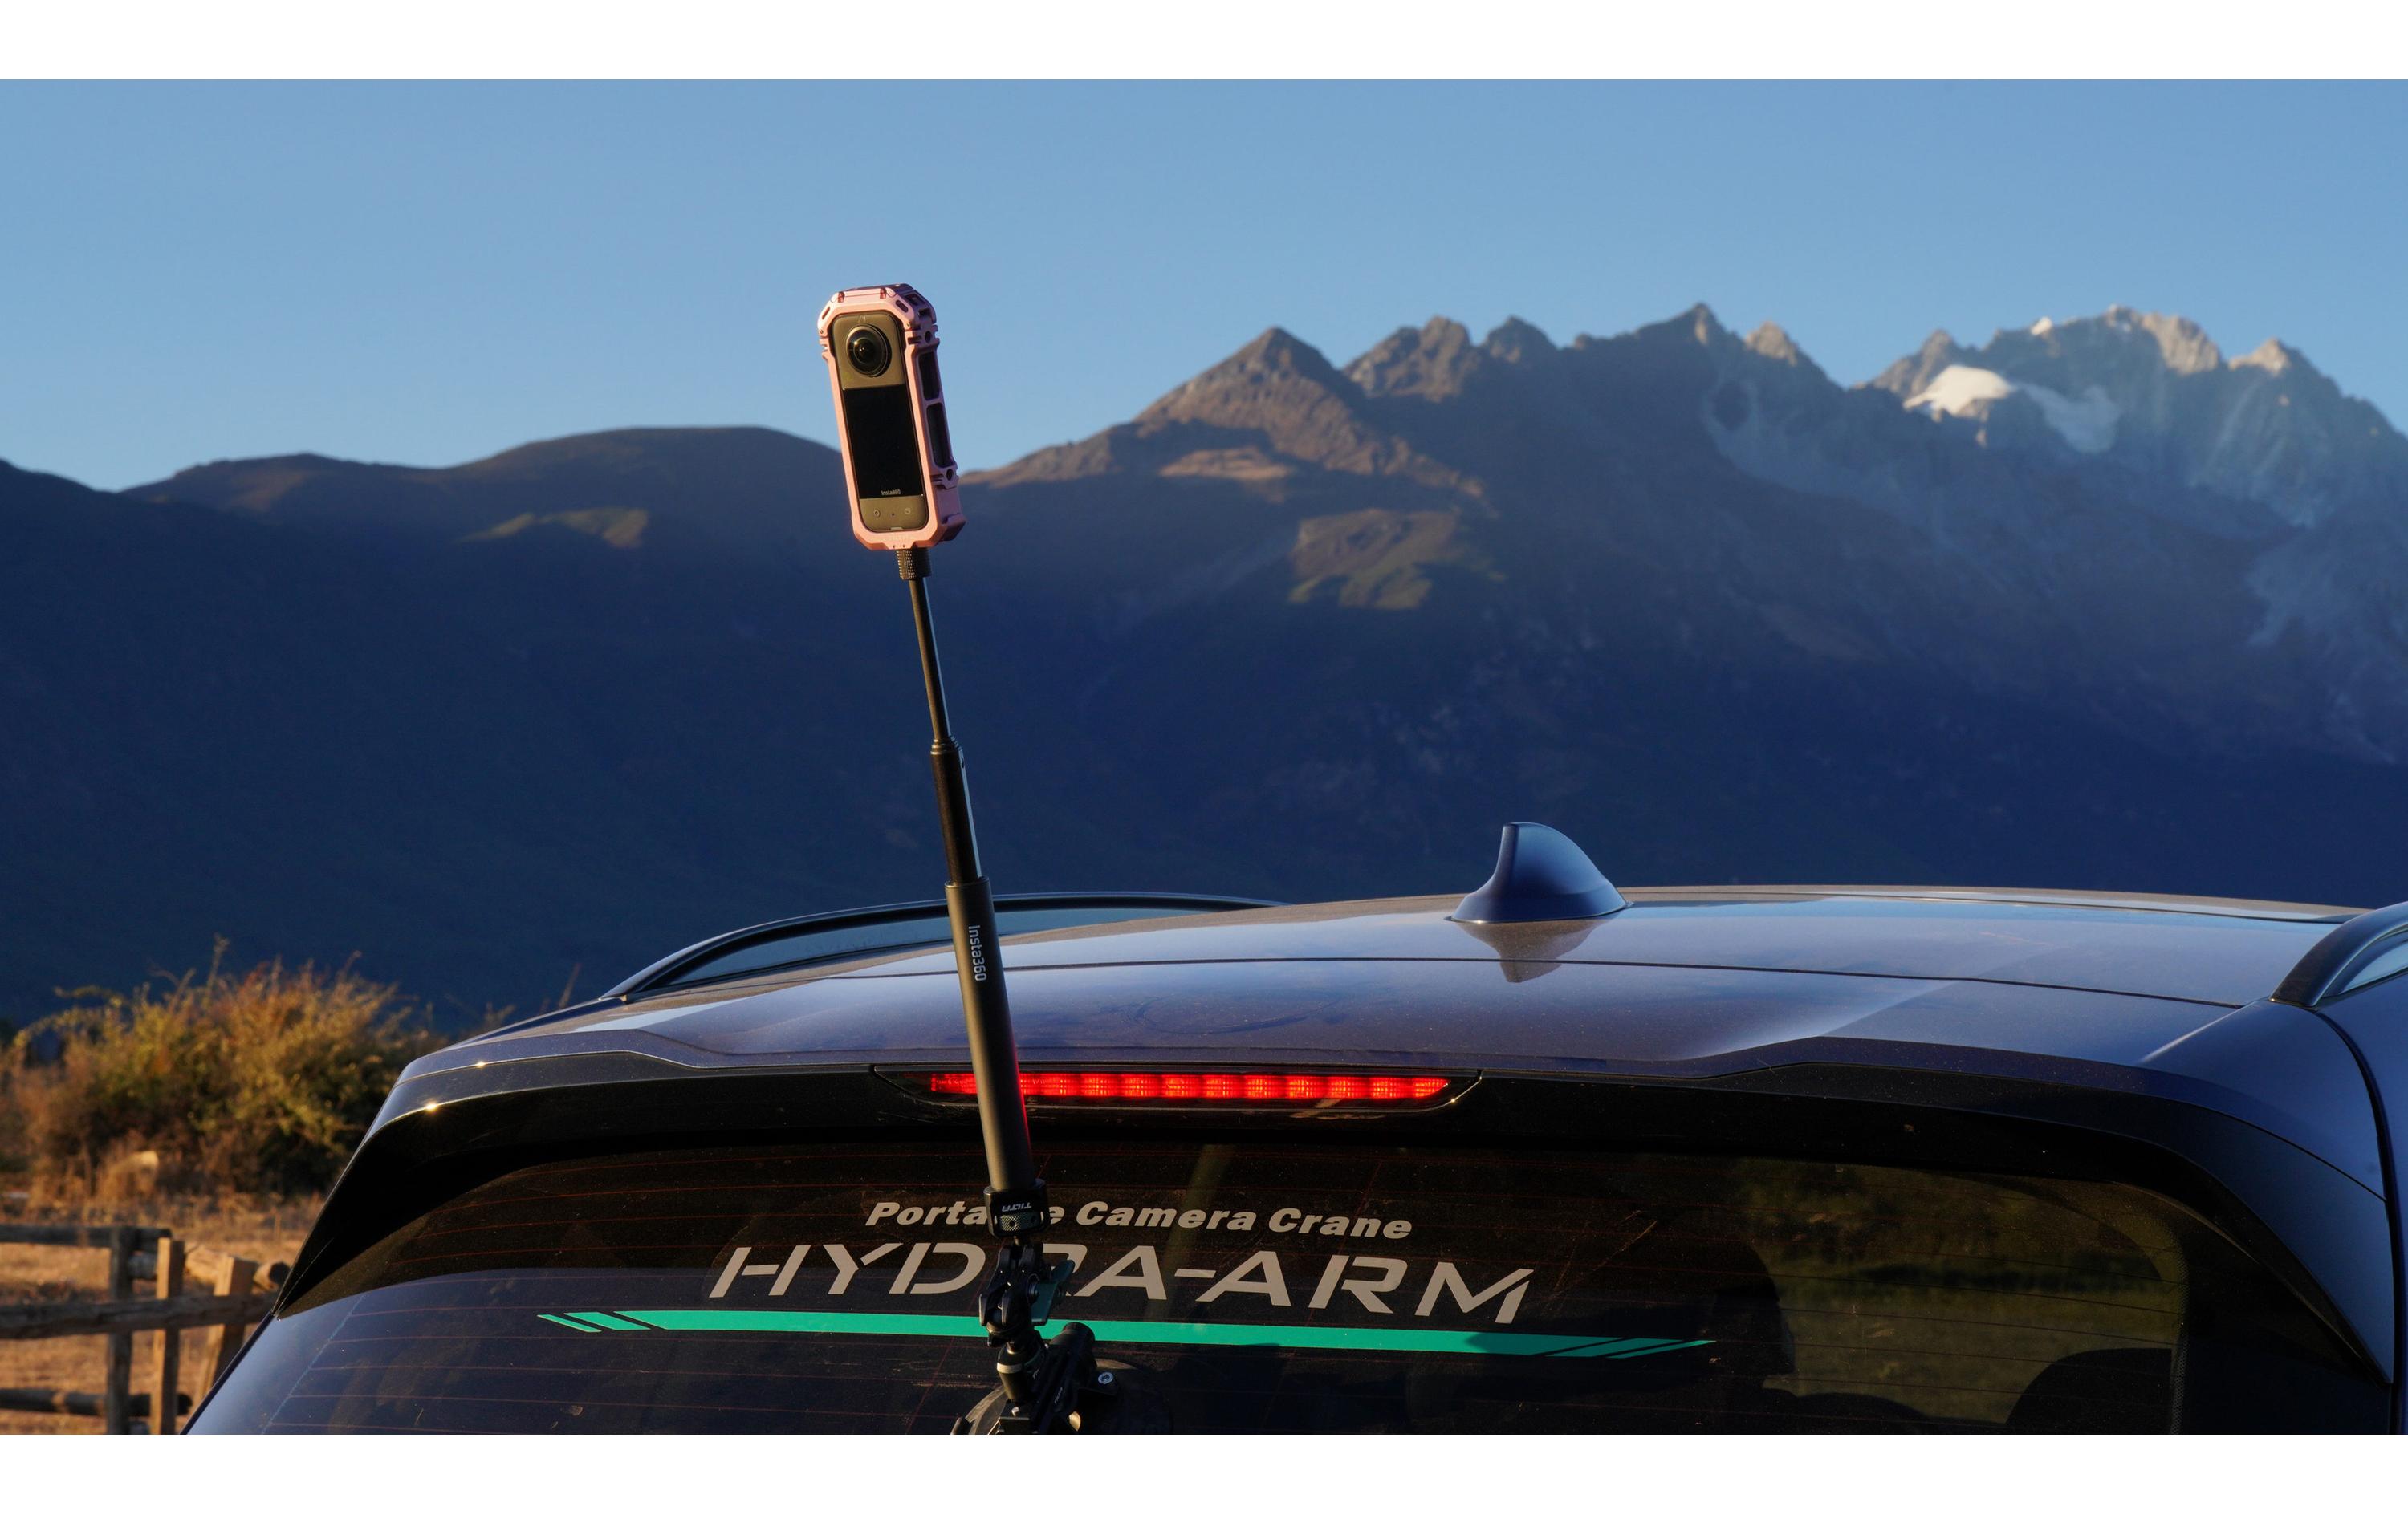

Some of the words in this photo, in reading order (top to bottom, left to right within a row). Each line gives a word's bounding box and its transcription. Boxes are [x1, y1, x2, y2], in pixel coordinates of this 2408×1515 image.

[968, 924, 987, 981] Insta360
[865, 1200, 1065, 1226] Portae
[1076, 1201, 1256, 1231] Camera
[1268, 1208, 1413, 1239] Crane
[1002, 1202, 1032, 1212] TILTA
